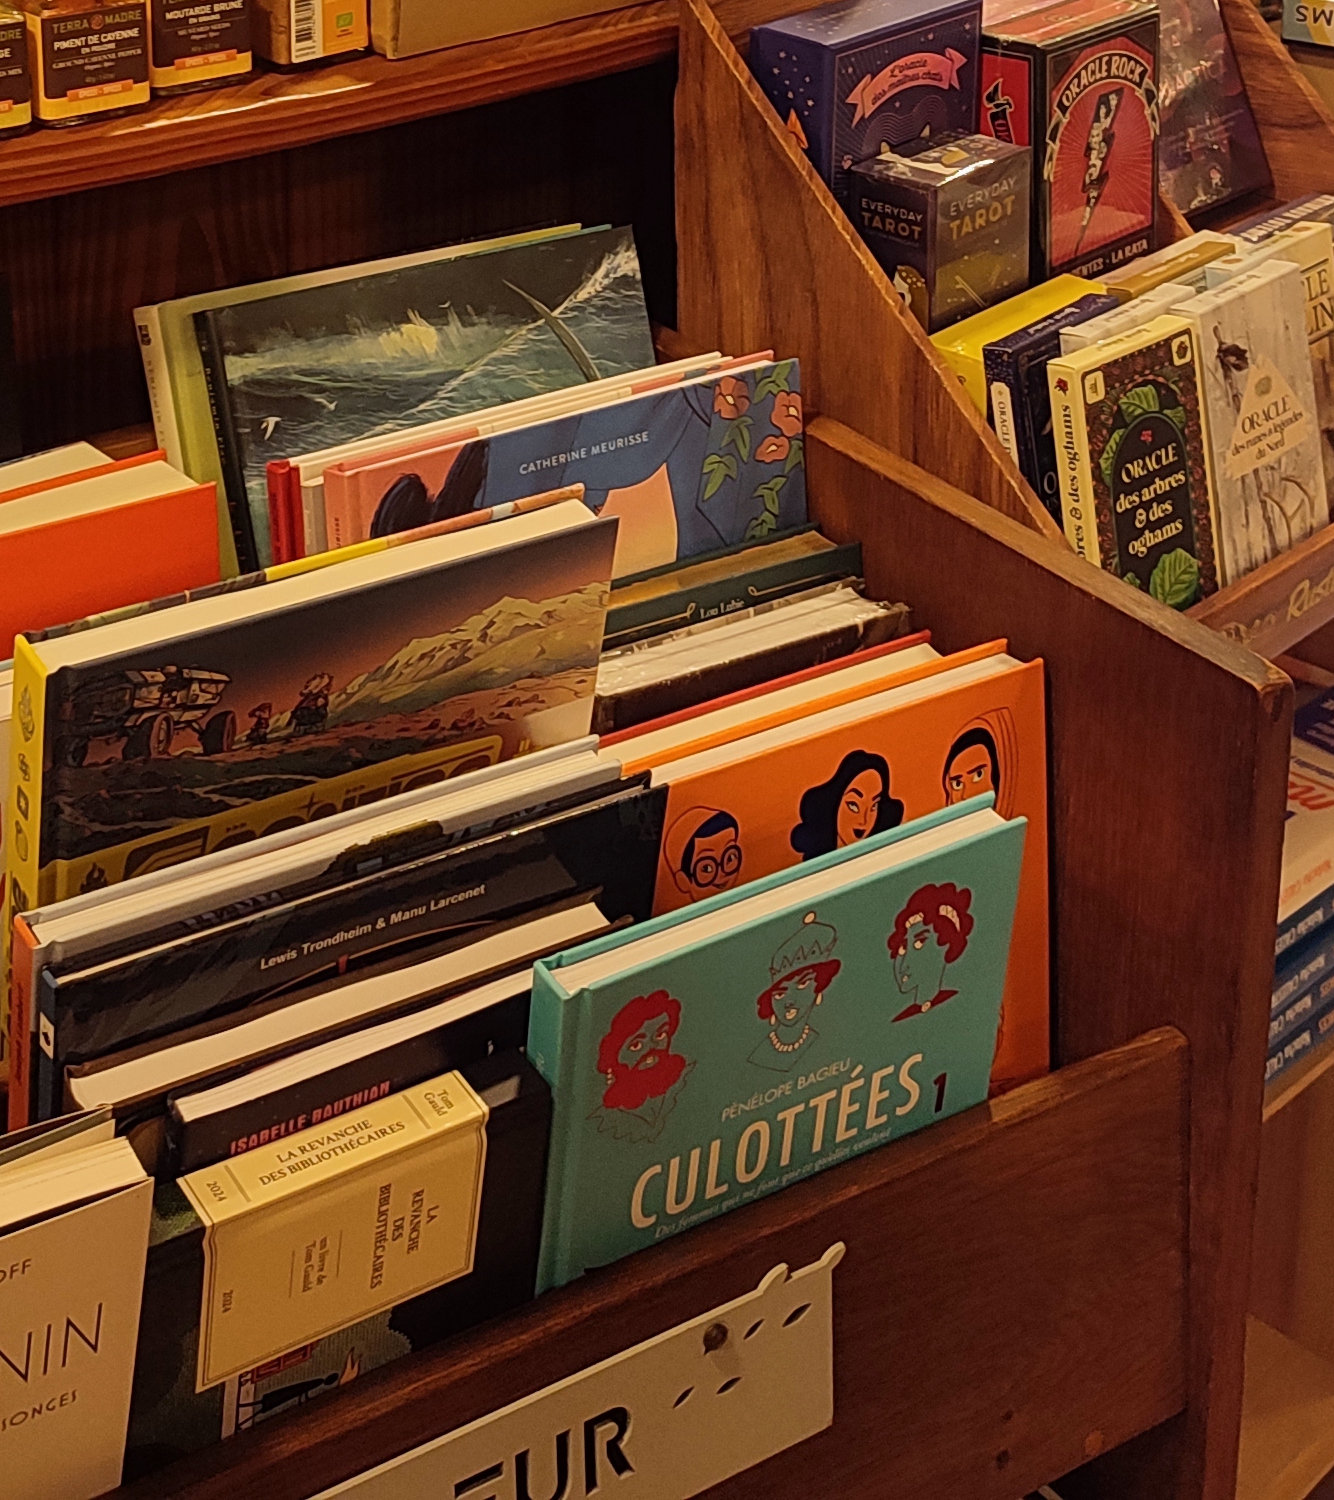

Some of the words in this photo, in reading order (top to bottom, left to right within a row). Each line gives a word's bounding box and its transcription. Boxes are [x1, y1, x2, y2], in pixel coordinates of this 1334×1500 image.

[53, 22, 89, 35] TERRA
[104, 9, 142, 24] MADRE
[165, 6, 211, 22] MOUTARDE
[213, 0, 244, 13] BRUNE
[54, 37, 86, 51] PIMENT
[87, 35, 101, 46] DE
[102, 28, 140, 42] CAYENNE
[1062, 55, 1110, 107] ORACLE
[1111, 55, 1145, 84] ROCK
[862, 198, 924, 223] EVERYDAY
[950, 177, 1017, 216] EVERYDAY
[862, 211, 922, 240] TAROT
[949, 194, 1016, 241] TAROT
[1241, 396, 1292, 435] ORACLE
[519, 445, 588, 476] CATHERINE
[590, 430, 650, 456] MEURISSE
[1061, 403, 1082, 471] oghams
[1121, 443, 1179, 485] ORACLE
[1116, 490, 1141, 515] des
[1141, 469, 1187, 502] arbres
[1149, 499, 1174, 522] des
[1128, 518, 1184, 559] oghams
[260, 946, 299, 970] Lewis
[301, 921, 374, 958] Trondheim
[375, 914, 387, 932] &
[389, 901, 428, 930] Manu
[429, 882, 487, 914] Larcenet
[424, 1091, 448, 1118] Gauld
[439, 1088, 455, 1110] Tom
[721, 1085, 794, 1124] PÉNÉLOPE
[797, 1055, 852, 1093] BAGIEU
[230, 1113, 307, 1156] ISABELLE
[311, 1080, 391, 1126] BAUTHIAN
[259, 1168, 287, 1187] DES
[287, 1120, 406, 1178] BIBLIOTHÉCAIRES
[276, 1149, 296, 1164] LA
[297, 1119, 374, 1156] REVANCHE
[630, 1052, 925, 1231] CULOTTÉES
[932, 1071, 948, 1115] 1
[206, 1180, 229, 1203] 2024
[391, 1216, 405, 1242] DES
[406, 1188, 425, 1256] REVANCHE
[425, 1204, 440, 1225] LA
[370, 1182, 392, 1290] BIBLIOTHÉCAIRES
